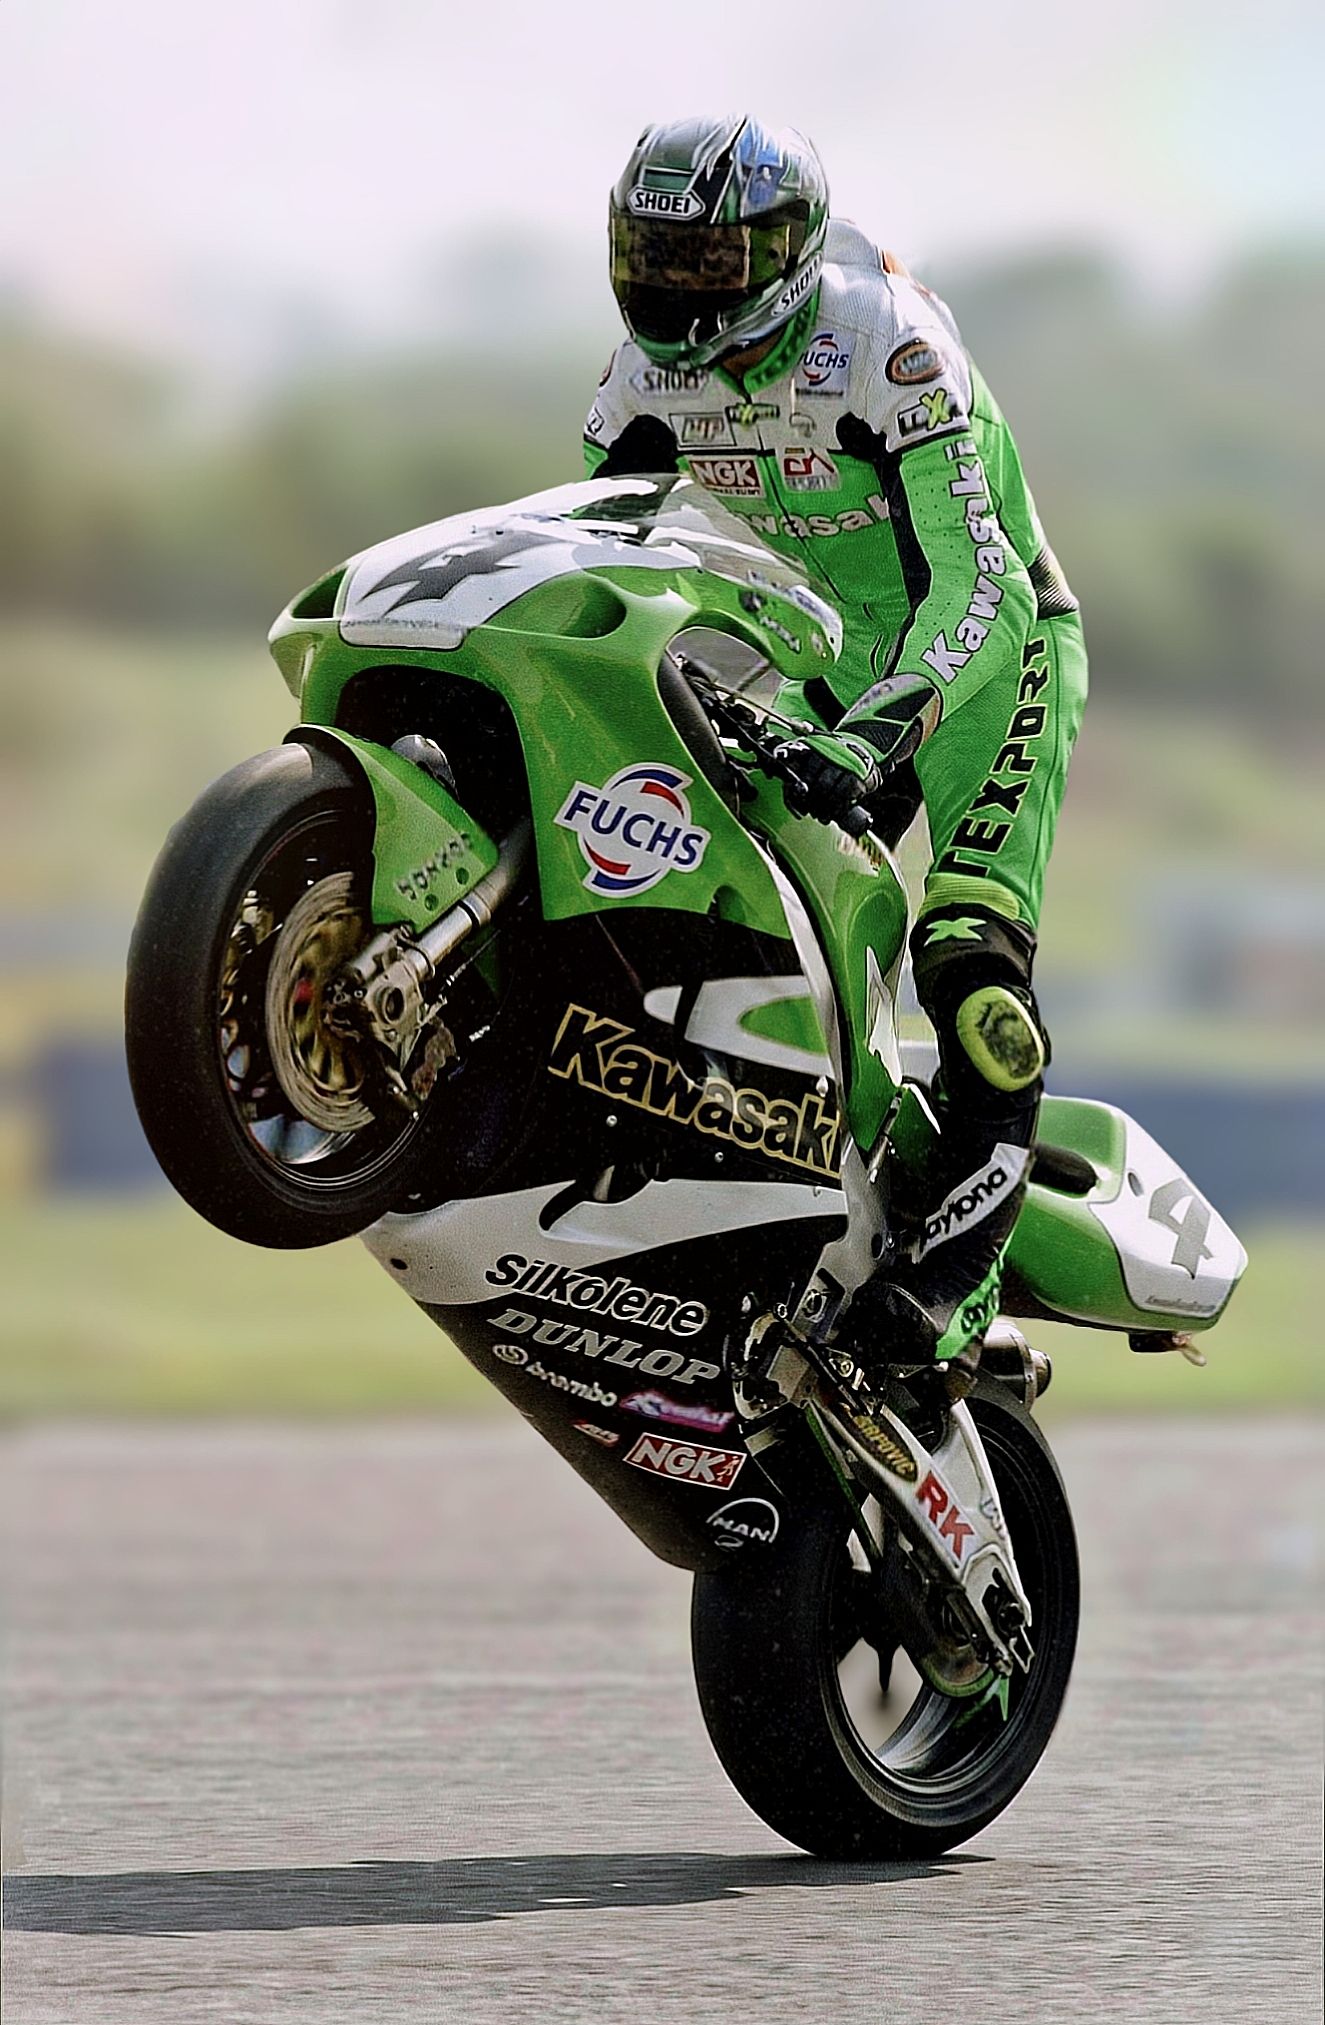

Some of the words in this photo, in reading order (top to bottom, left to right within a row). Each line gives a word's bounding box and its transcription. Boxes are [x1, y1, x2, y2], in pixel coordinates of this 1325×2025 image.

[635, 192, 691, 214] SHOEI
[798, 349, 849, 369] UCHS
[692, 461, 756, 486] NGK
[920, 438, 1006, 686] Kawasaki
[937, 638, 1049, 877] TEXPORT
[563, 789, 703, 866] FUCHS
[1149, 1177, 1214, 1280] 4
[485, 1253, 707, 1336] Silkolene
[486, 1308, 721, 1385] DUNLOP
[631, 1438, 727, 1483] NGK
[713, 1517, 771, 1542] MAN
[915, 1470, 975, 1561] RK
